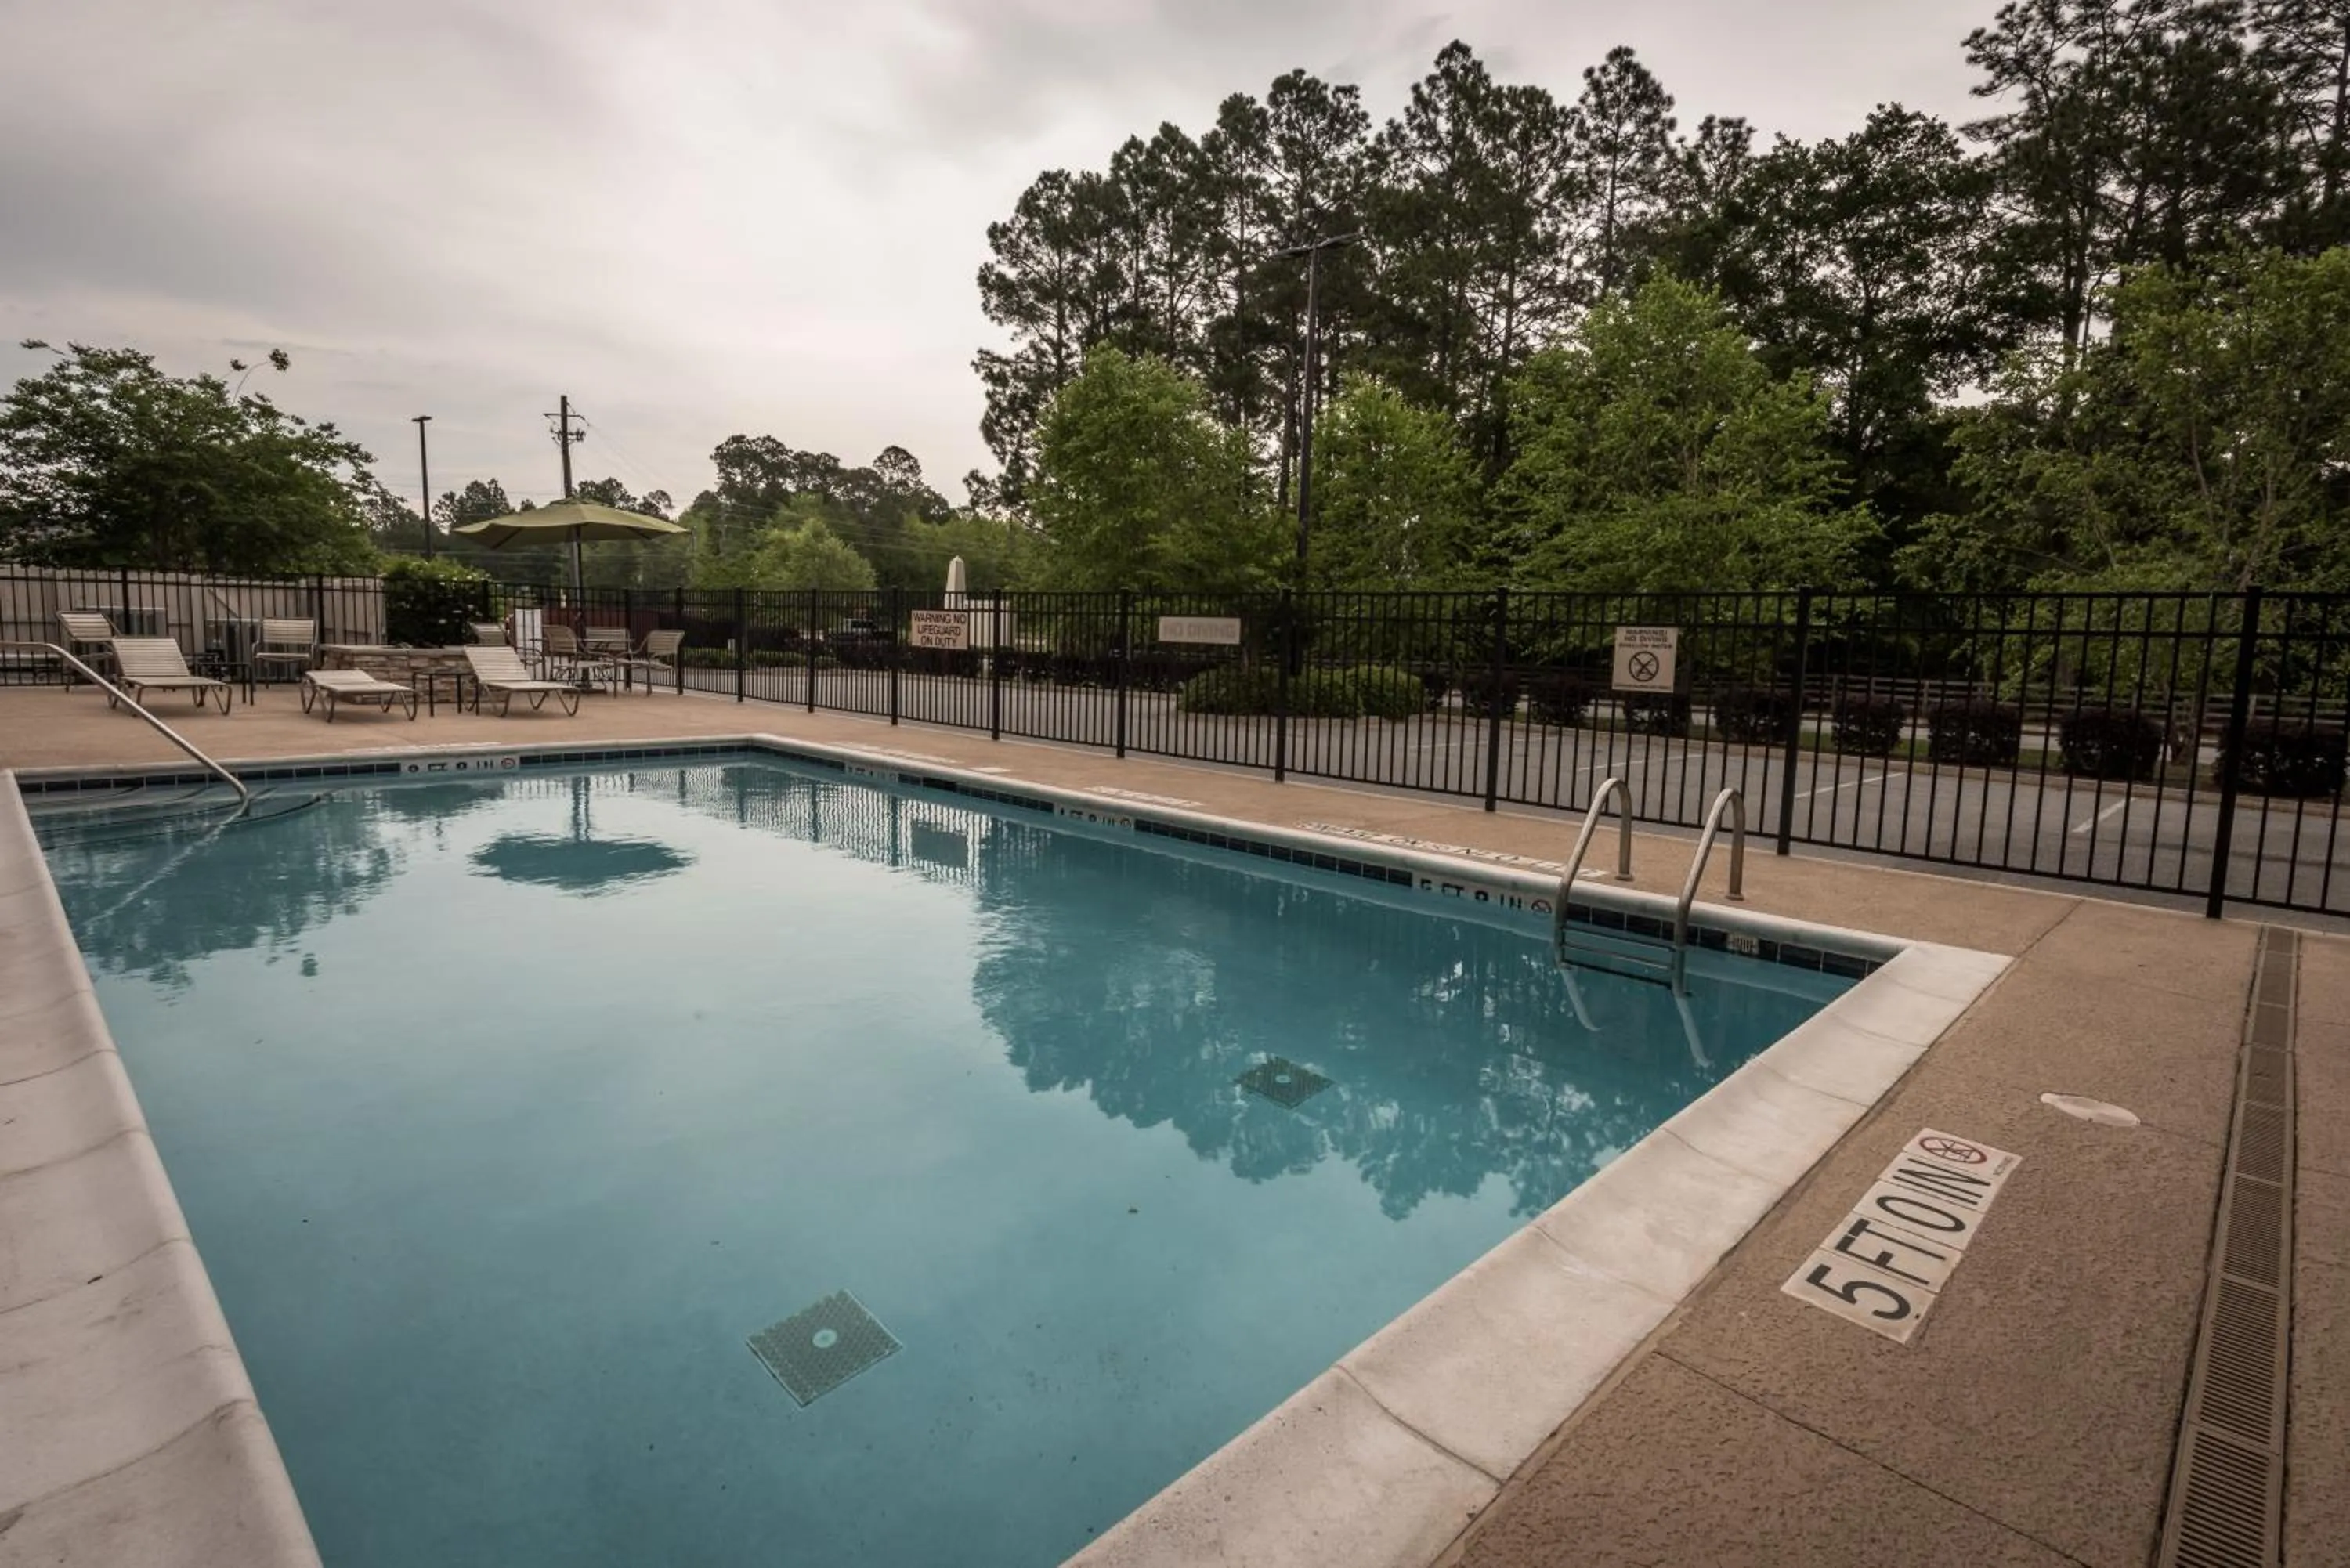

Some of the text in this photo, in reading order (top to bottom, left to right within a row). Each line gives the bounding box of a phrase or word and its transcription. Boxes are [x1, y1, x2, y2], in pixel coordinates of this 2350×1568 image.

[913, 612, 966, 624] WARNING NO
[917, 625, 960, 636] LIFEGUARD
[921, 635, 956, 647] ON DUTY
